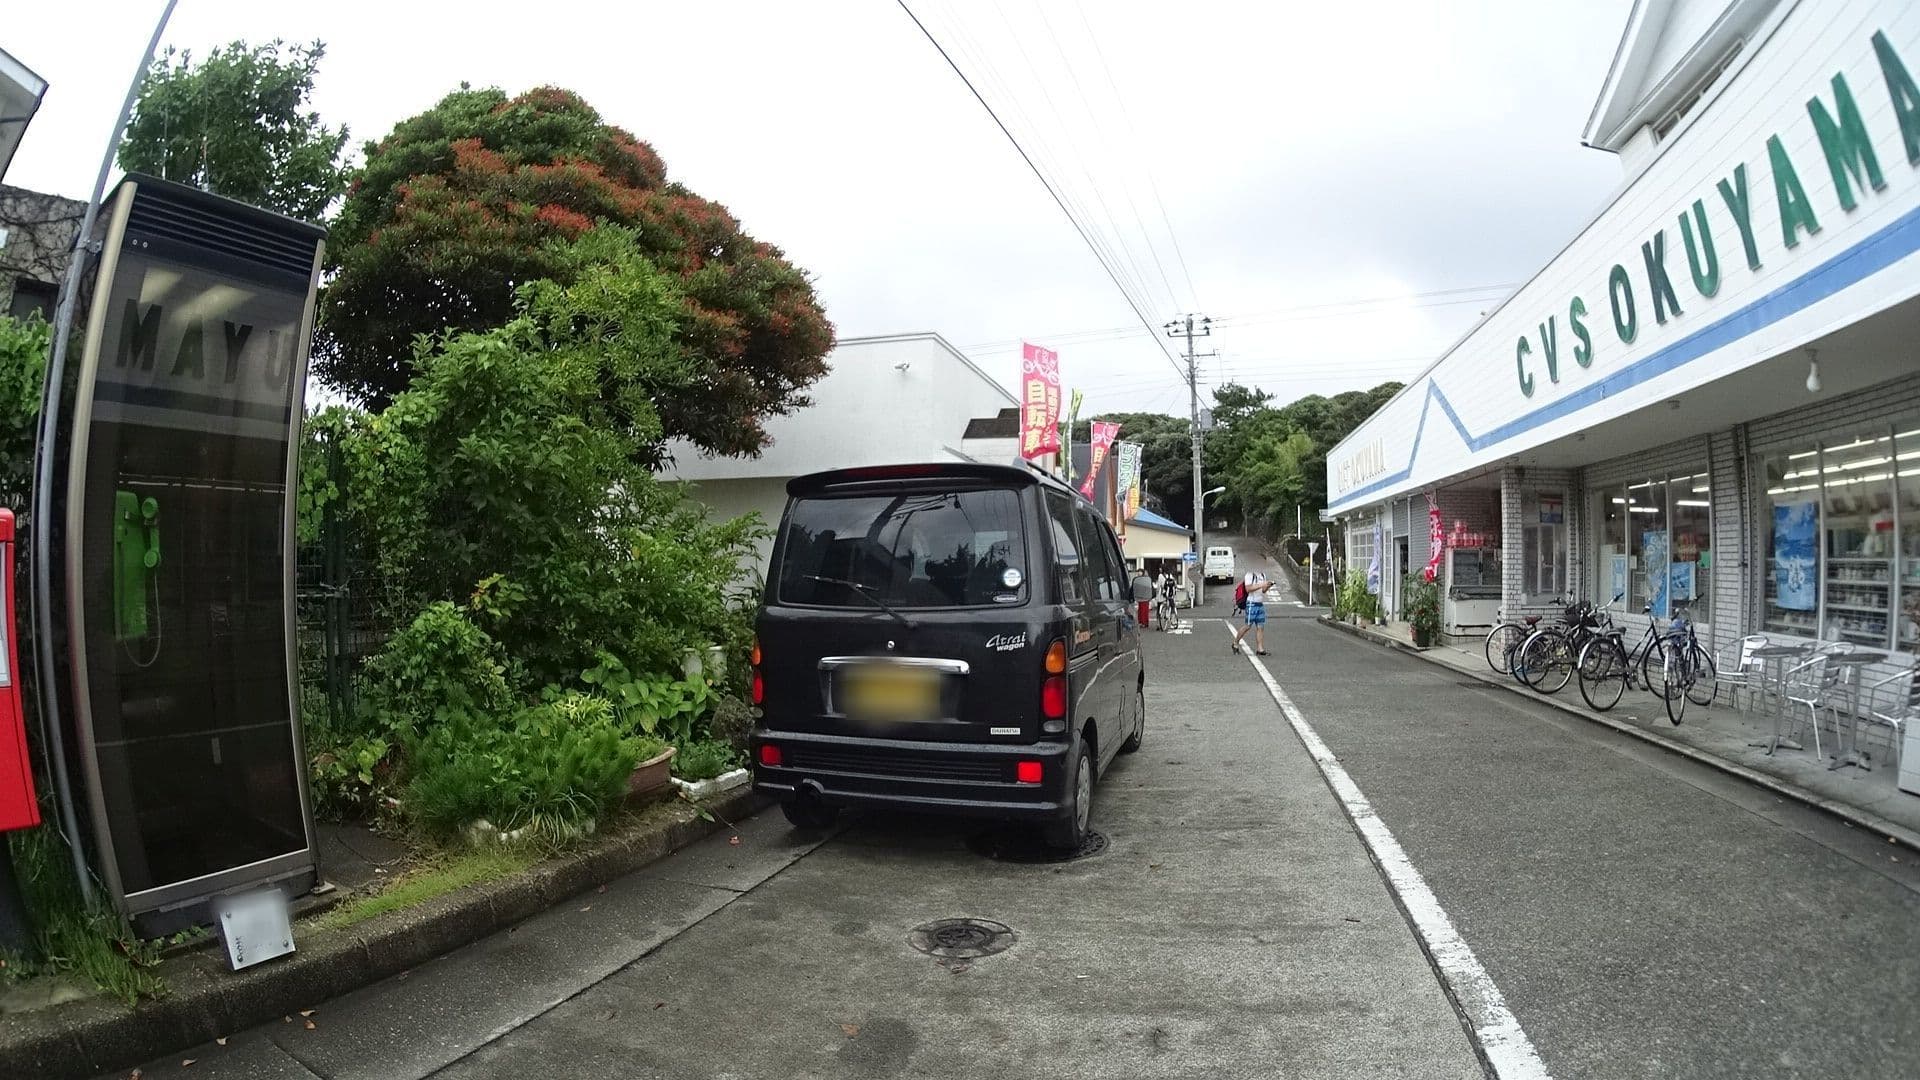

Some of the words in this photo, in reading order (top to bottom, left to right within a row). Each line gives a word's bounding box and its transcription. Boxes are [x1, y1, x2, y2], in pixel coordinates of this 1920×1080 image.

[1516, 296, 1594, 398] CVS
[1024, 379, 1047, 453] 自転車
[986, 632, 1026, 648] Atrai
[997, 642, 1024, 652] wagon
